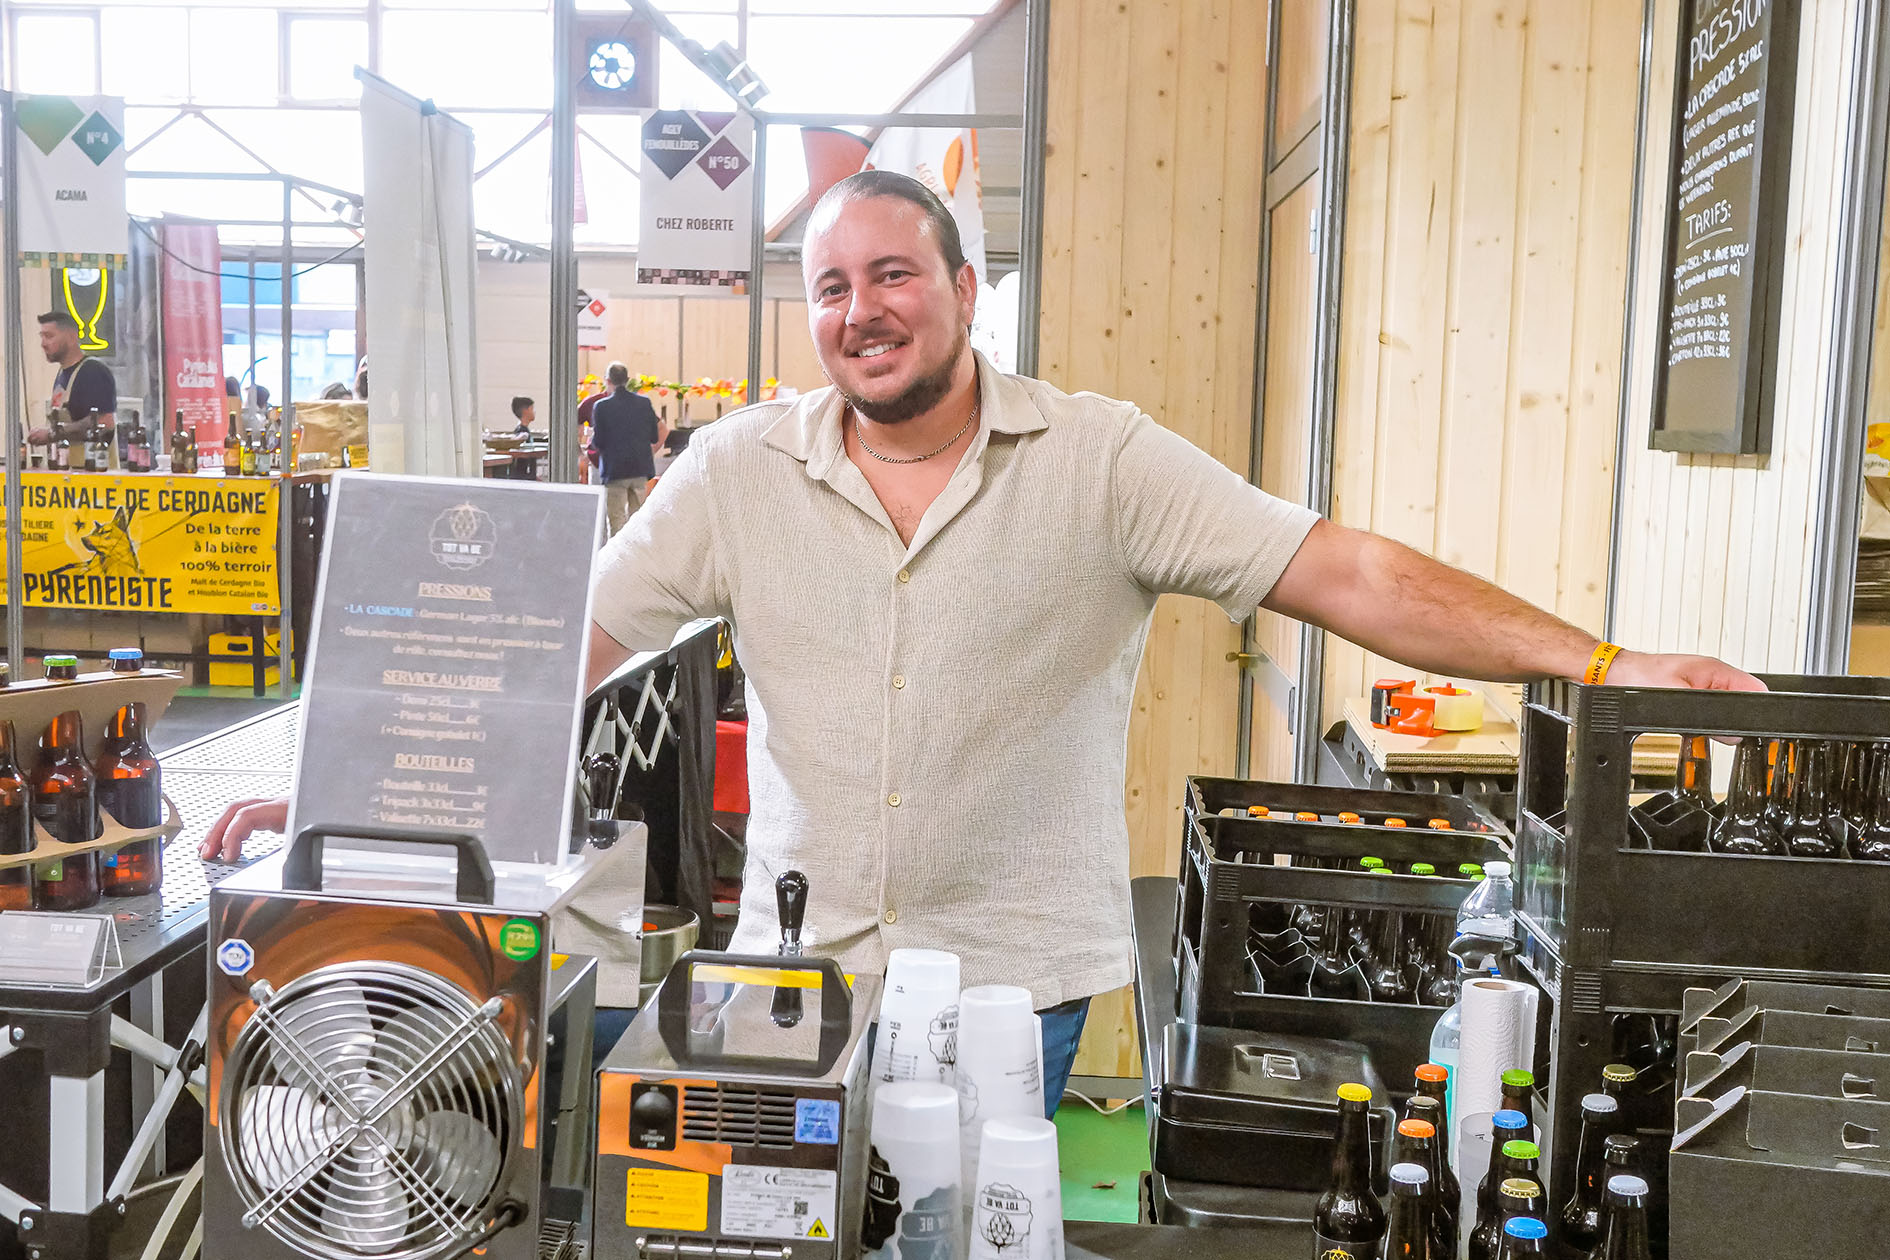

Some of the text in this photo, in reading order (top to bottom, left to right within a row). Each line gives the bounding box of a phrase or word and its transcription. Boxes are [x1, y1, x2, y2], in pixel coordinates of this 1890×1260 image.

[708, 155, 740, 170] N°50
[55, 190, 88, 202] ACAMA
[656, 217, 734, 231] CHEZ ROBERTE
[3, 484, 267, 515] TISANALE DE CERDAGNE
[186, 523, 261, 536] De la terre
[194, 541, 258, 554] à la bière
[180, 560, 272, 573] 100% terroir
[418, 582, 493, 599] PRESSIONS
[349, 603, 363, 614] LA
[995, 1200, 1003, 1210] VA
[1005, 1201, 1019, 1211] TOT
[919, 1216, 934, 1232] BE
